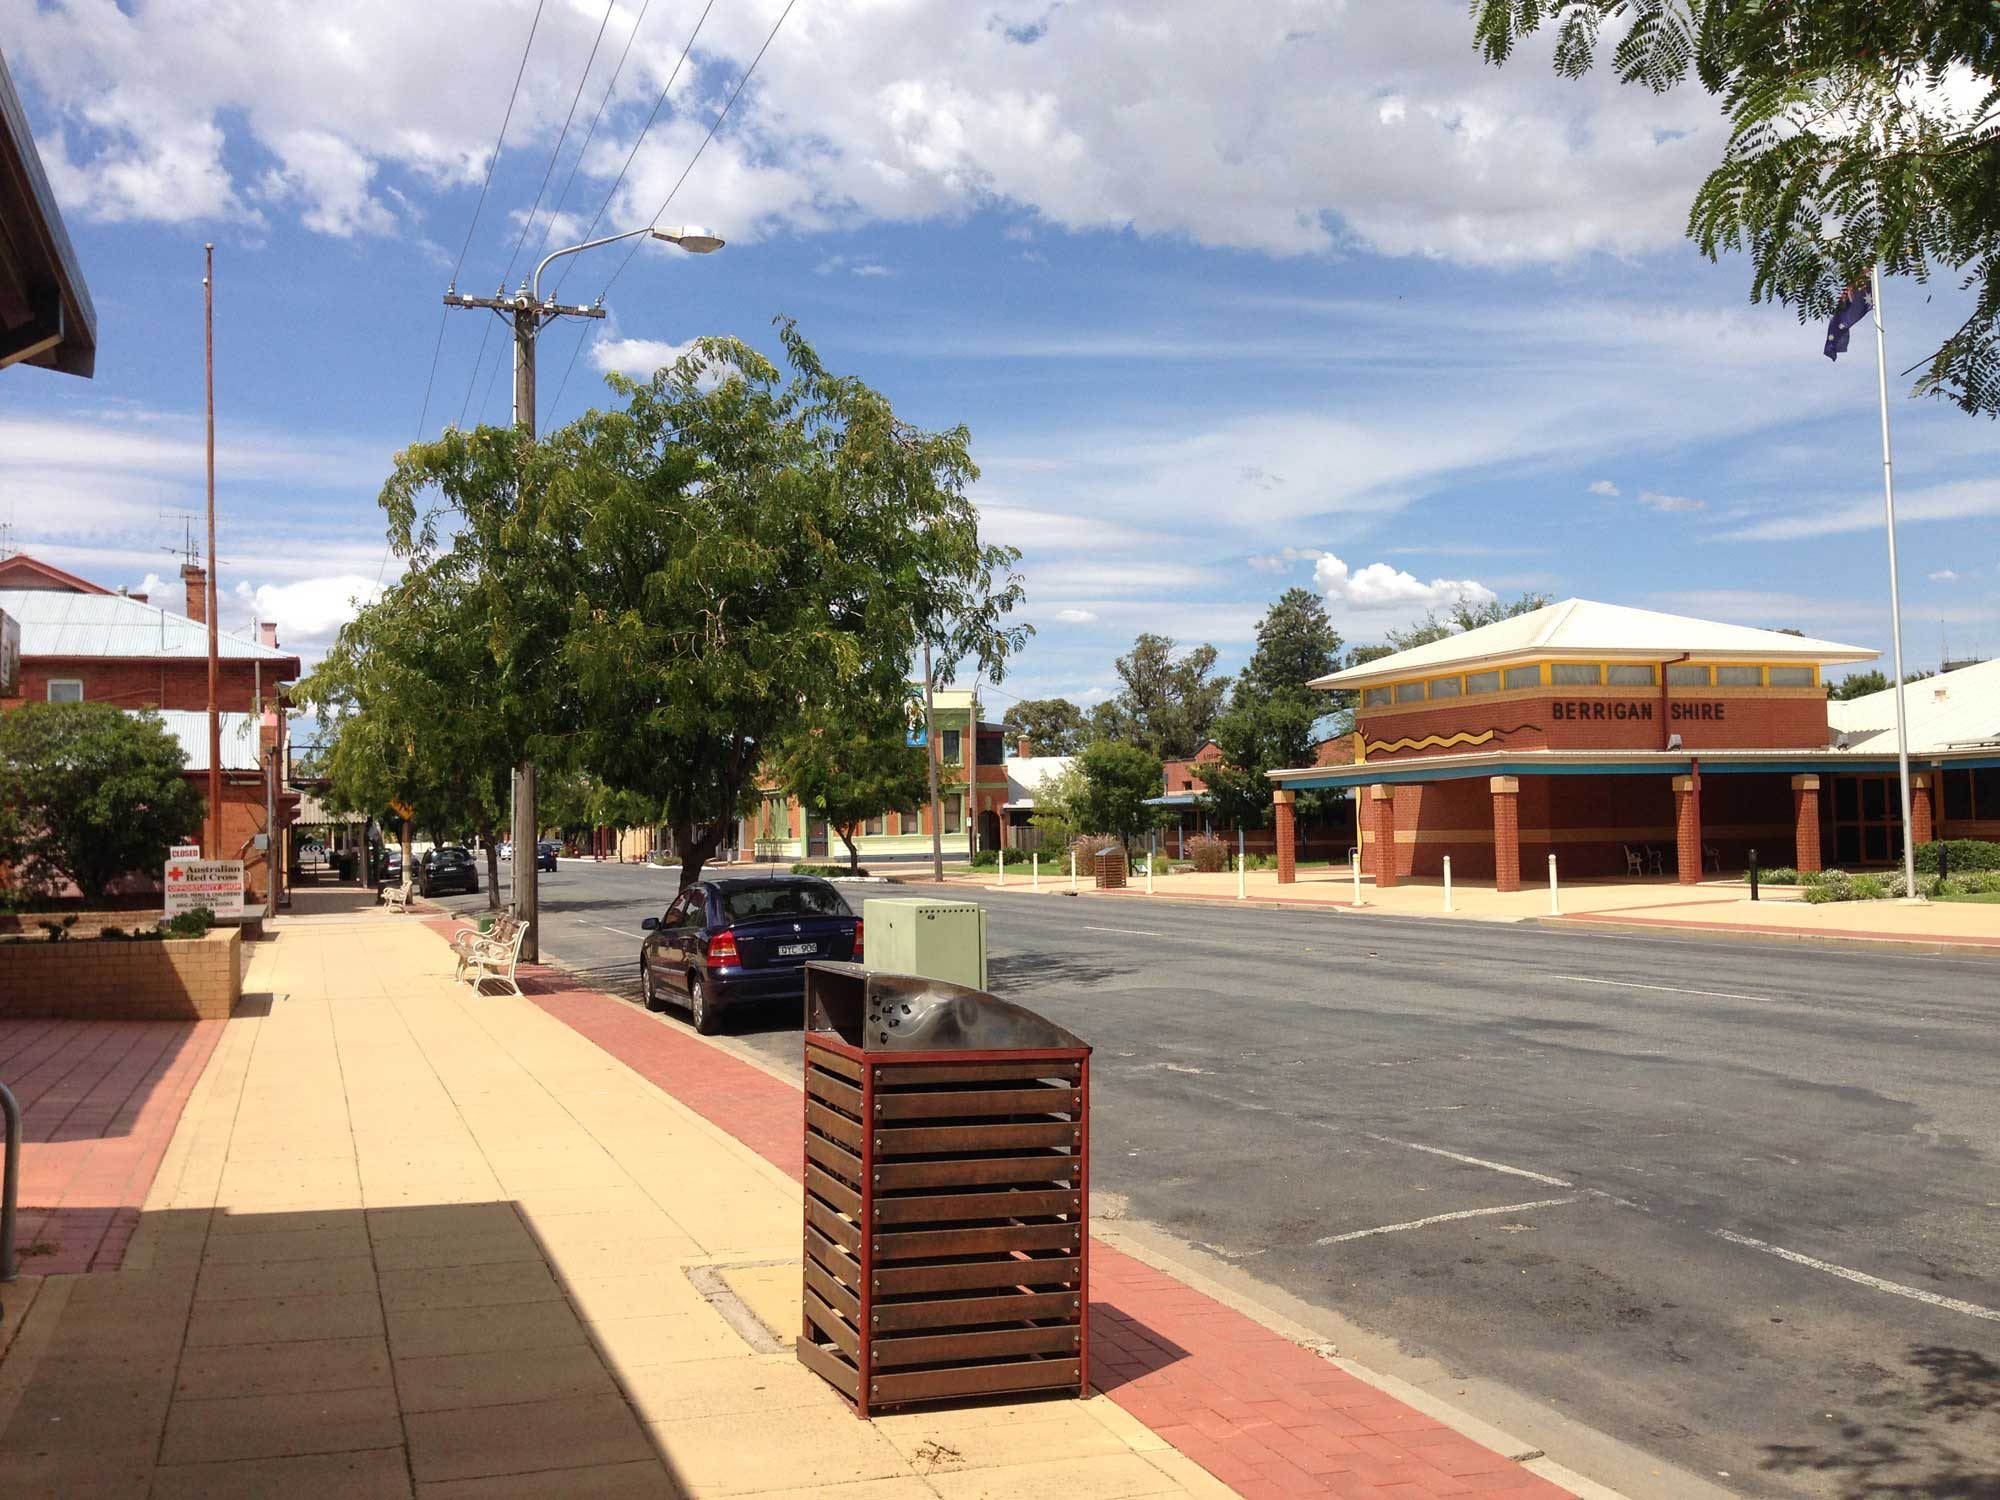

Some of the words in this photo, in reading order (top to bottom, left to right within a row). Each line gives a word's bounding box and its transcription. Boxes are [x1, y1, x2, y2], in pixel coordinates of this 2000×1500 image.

[1552, 702, 1653, 721] BERRIGAN
[1670, 702, 1725, 720] SHIRE
[172, 849, 199, 858] CLOSED
[186, 865, 241, 874] Australian
[186, 873, 206, 882] Red
[168, 884, 217, 892] OPPORTUNITY
